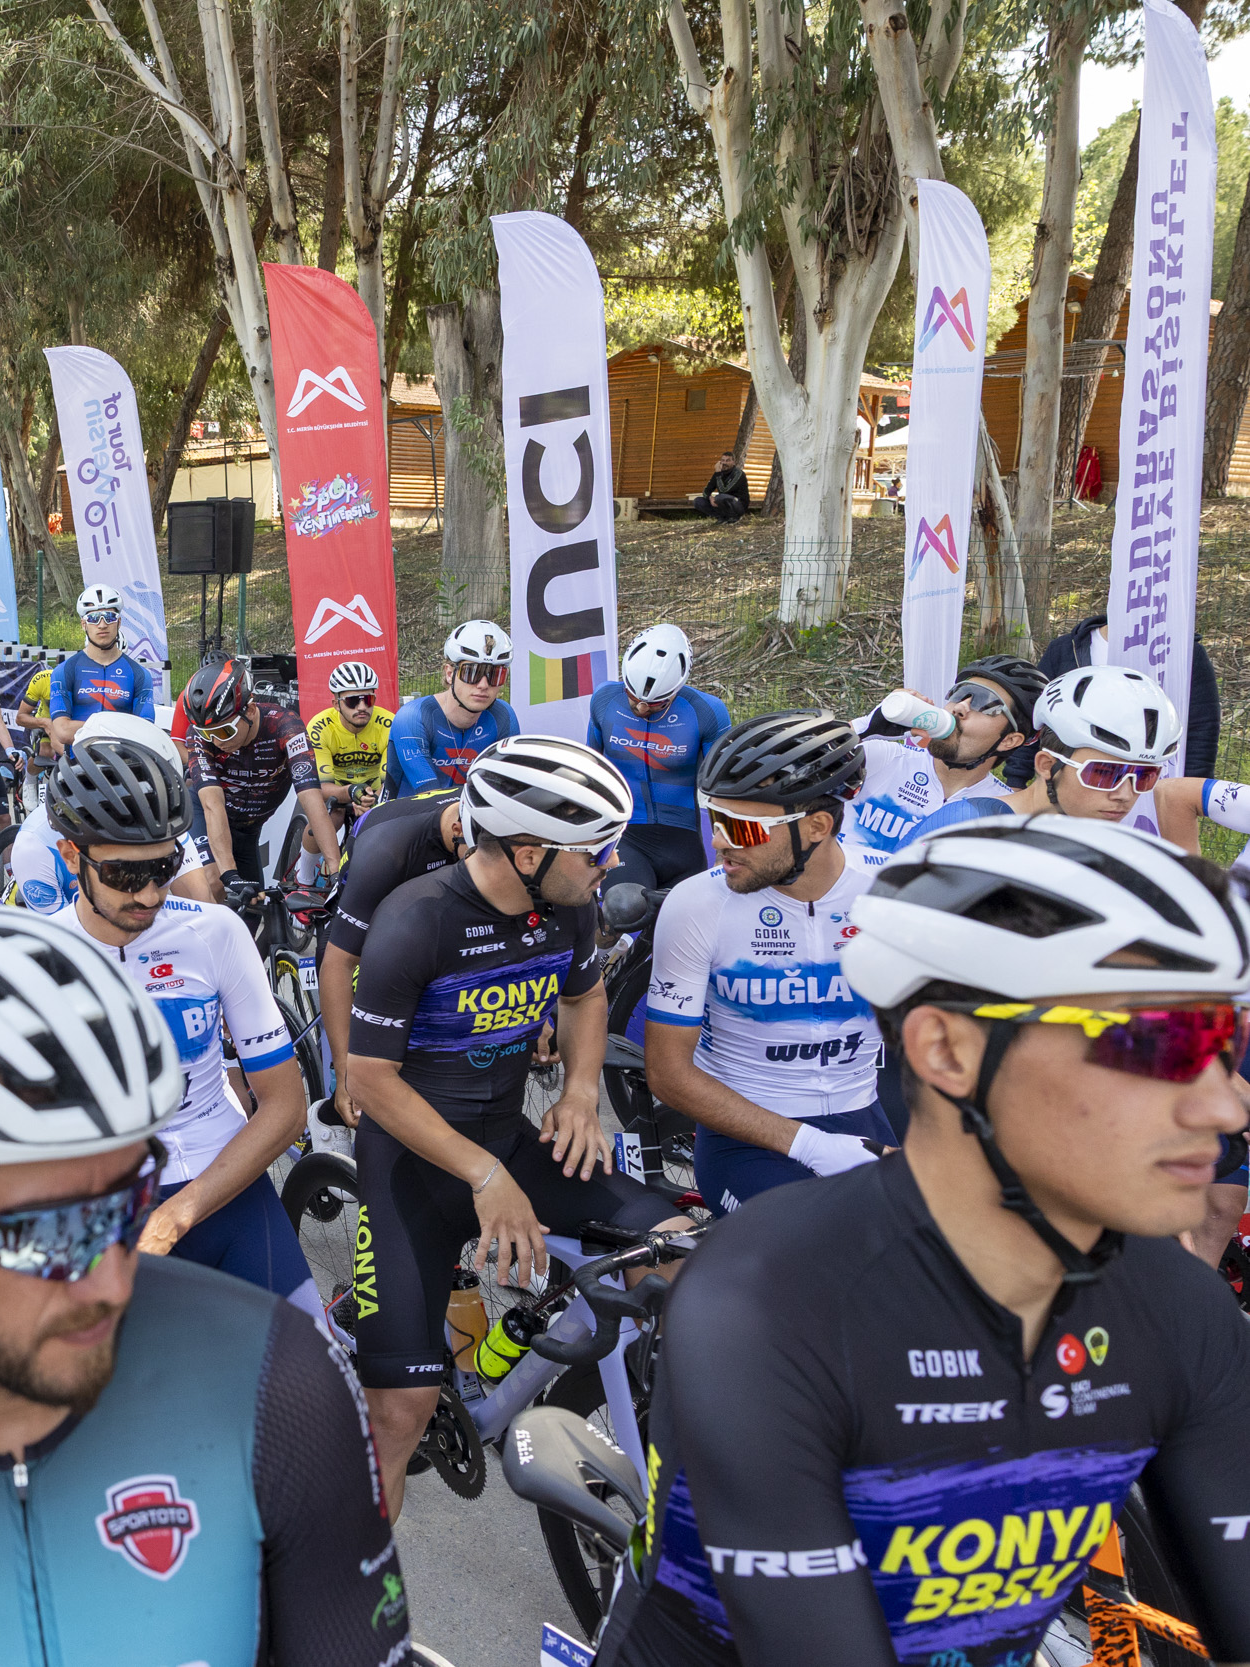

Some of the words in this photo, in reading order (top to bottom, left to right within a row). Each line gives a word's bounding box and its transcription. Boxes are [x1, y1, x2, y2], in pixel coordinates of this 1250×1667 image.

[78, 687, 131, 698] ROULEURS
[311, 716, 335, 750] KONYA
[288, 737, 304, 749] you
[292, 743, 306, 753] me
[610, 735, 688, 753] ROULEURS
[334, 752, 382, 762] KONYA
[898, 787, 929, 804] SHIMANO
[904, 780, 929, 797] GOBIK
[897, 794, 925, 808] TREK
[337, 907, 370, 932] TRE
[465, 924, 494, 939] GOBIK
[755, 928, 791, 940] GOBIK
[459, 942, 506, 957] TREK
[751, 941, 796, 949] SHIMANO
[457, 973, 559, 1013] KONYA
[716, 969, 854, 1005] MUĞLA
[351, 1004, 406, 1028] REK
[625, 1144, 642, 1174] 73
[908, 1349, 984, 1378] GOBIK
[895, 1399, 1009, 1424] TREK
[107, 1507, 190, 1537] SPORTOTO
[880, 1502, 1113, 1575] KONYA
